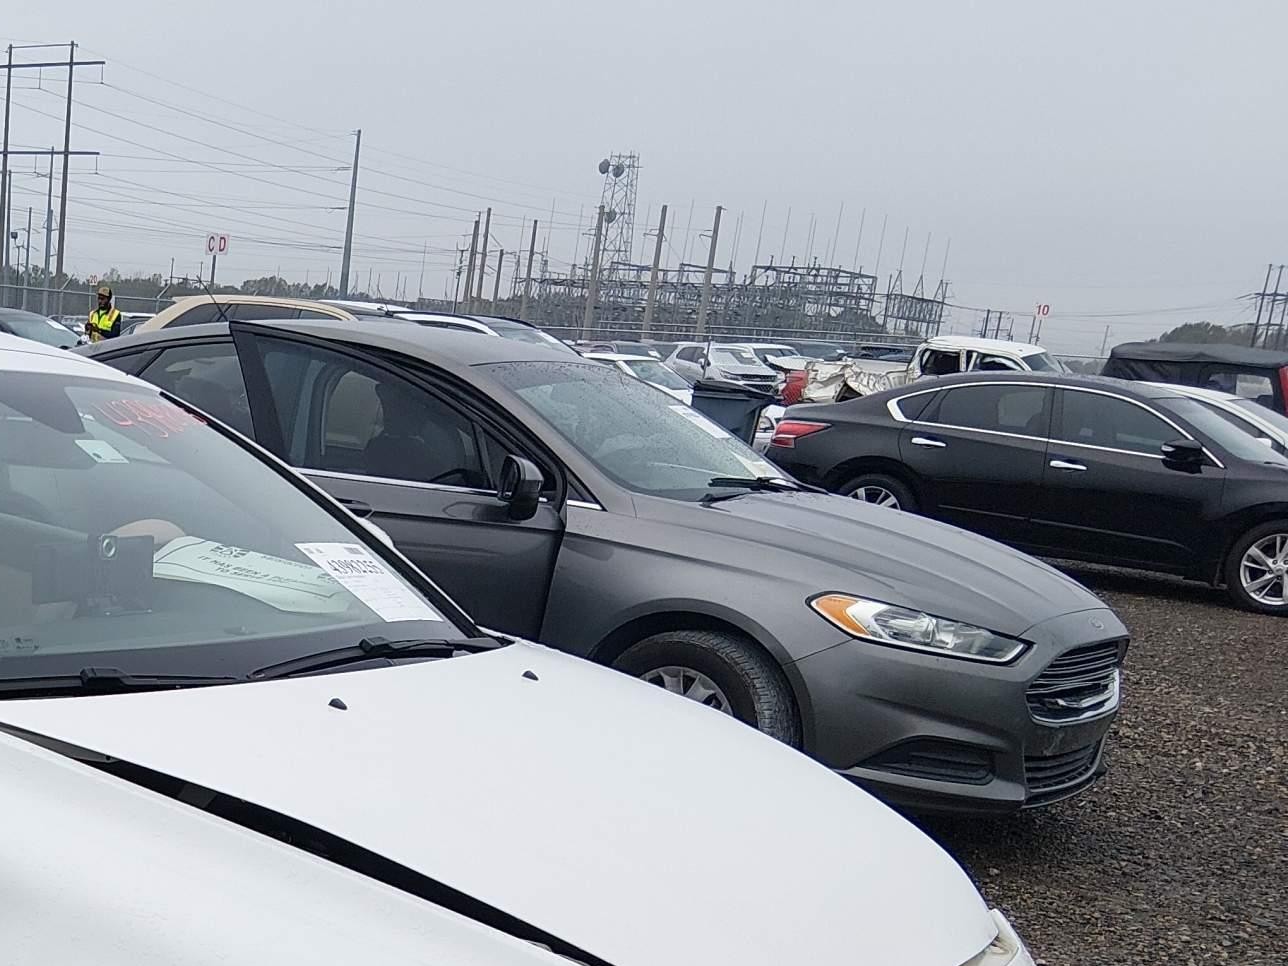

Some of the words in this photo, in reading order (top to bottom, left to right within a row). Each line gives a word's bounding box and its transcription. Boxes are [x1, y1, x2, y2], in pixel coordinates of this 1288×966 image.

[208, 236, 215, 252] C
[219, 236, 226, 252] D
[1036, 304, 1050, 316] 10
